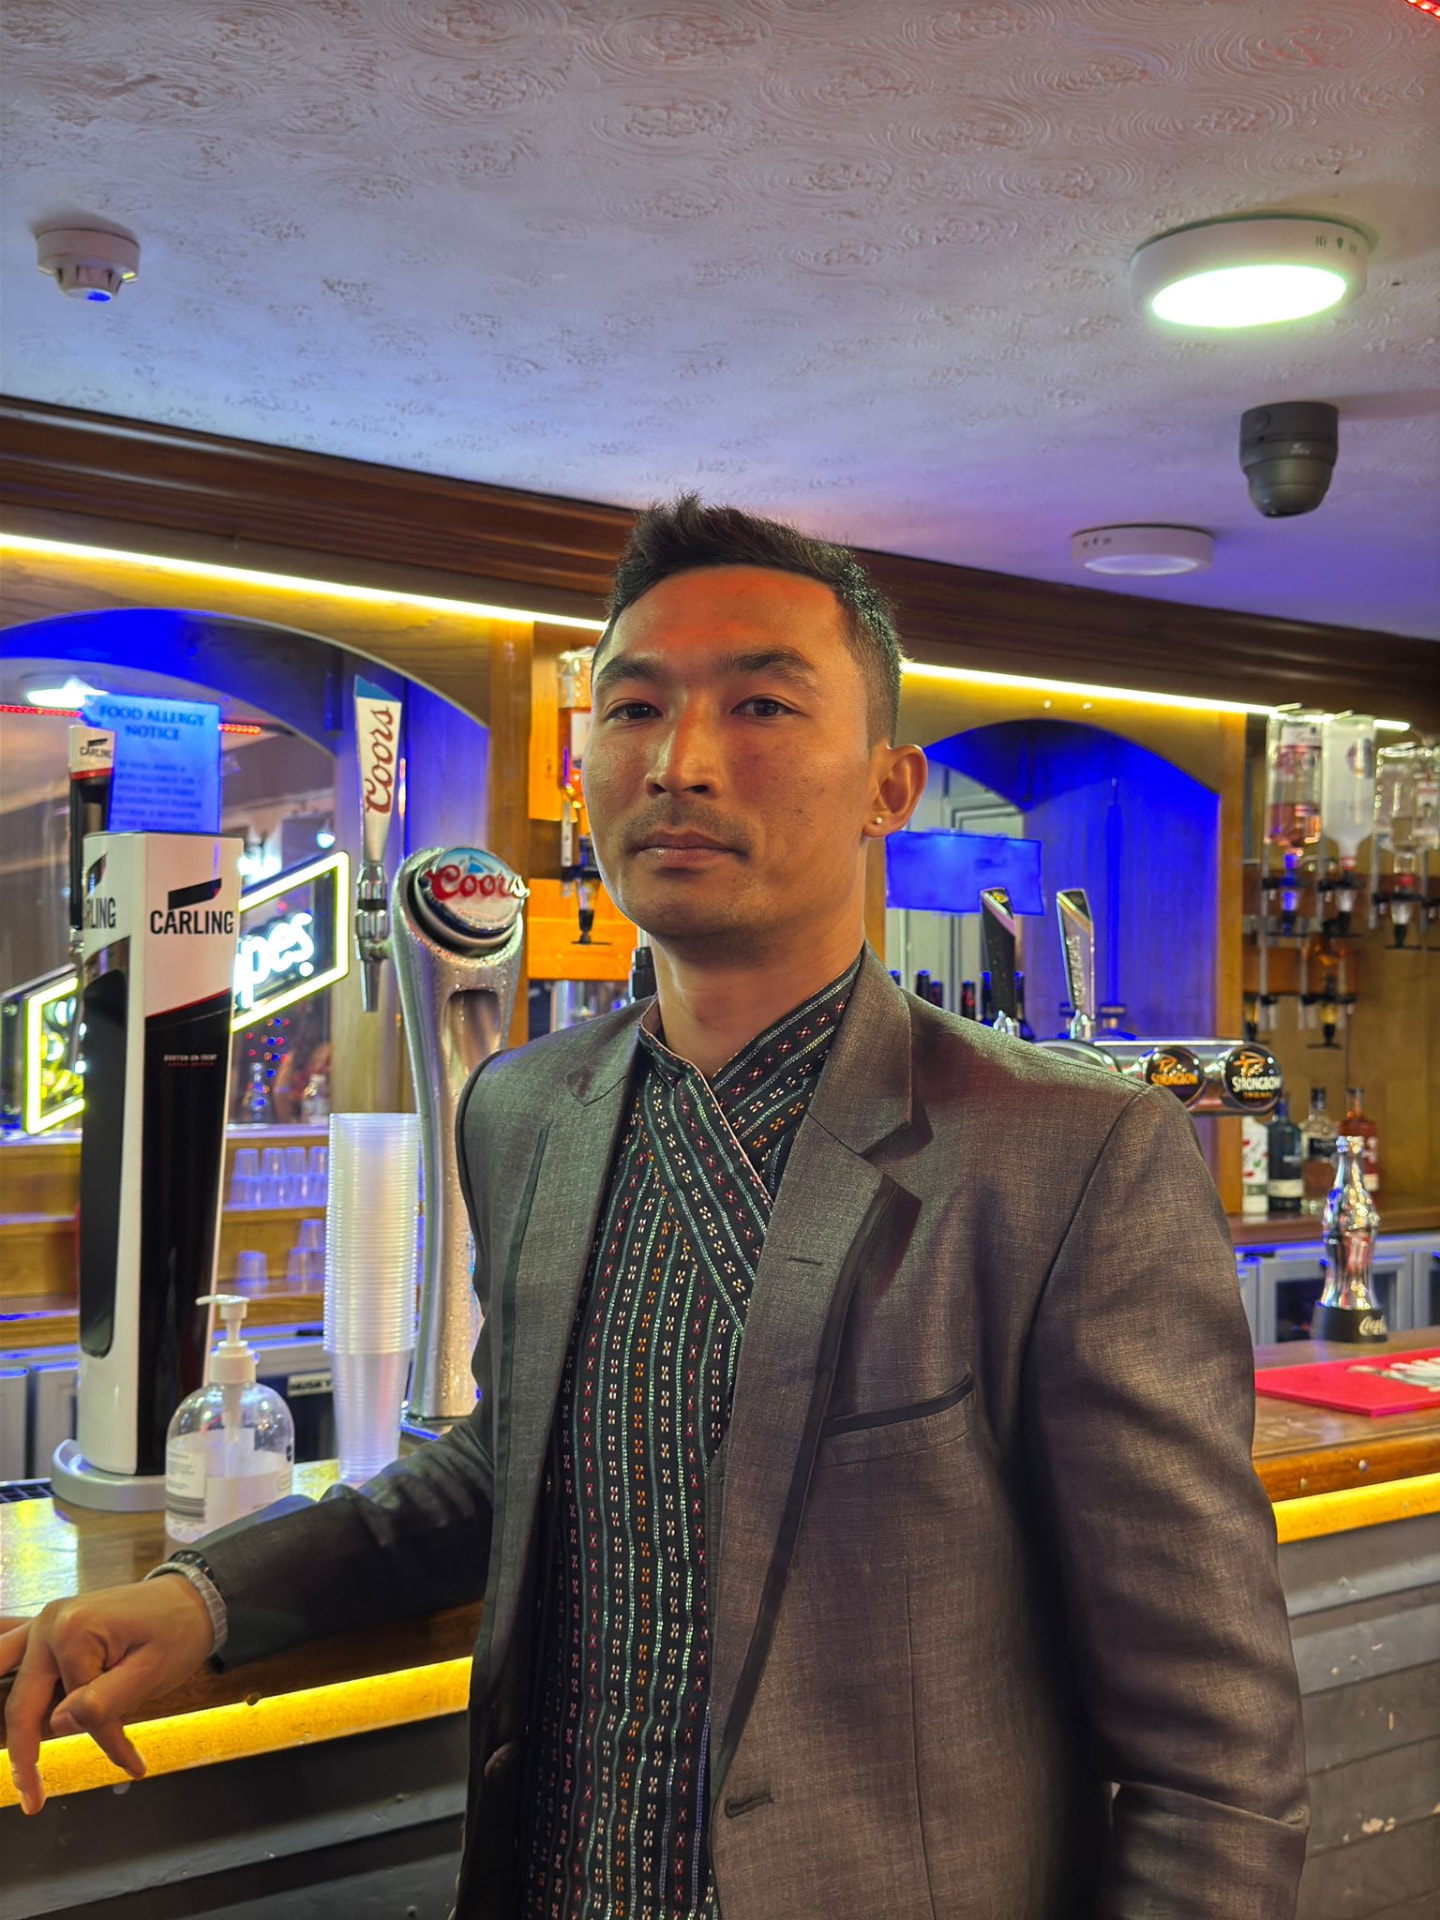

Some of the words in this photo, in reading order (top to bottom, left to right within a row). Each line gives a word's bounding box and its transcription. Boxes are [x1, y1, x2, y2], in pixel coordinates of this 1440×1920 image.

[99, 705, 143, 719] FOOD
[147, 710, 205, 726] ALLERGY
[124, 725, 180, 740] NOTICE
[363, 706, 394, 814] Coors
[426, 865, 531, 900] Coors
[150, 910, 234, 935] CARLING
[1231, 1075, 1281, 1092] STRONGBOW
